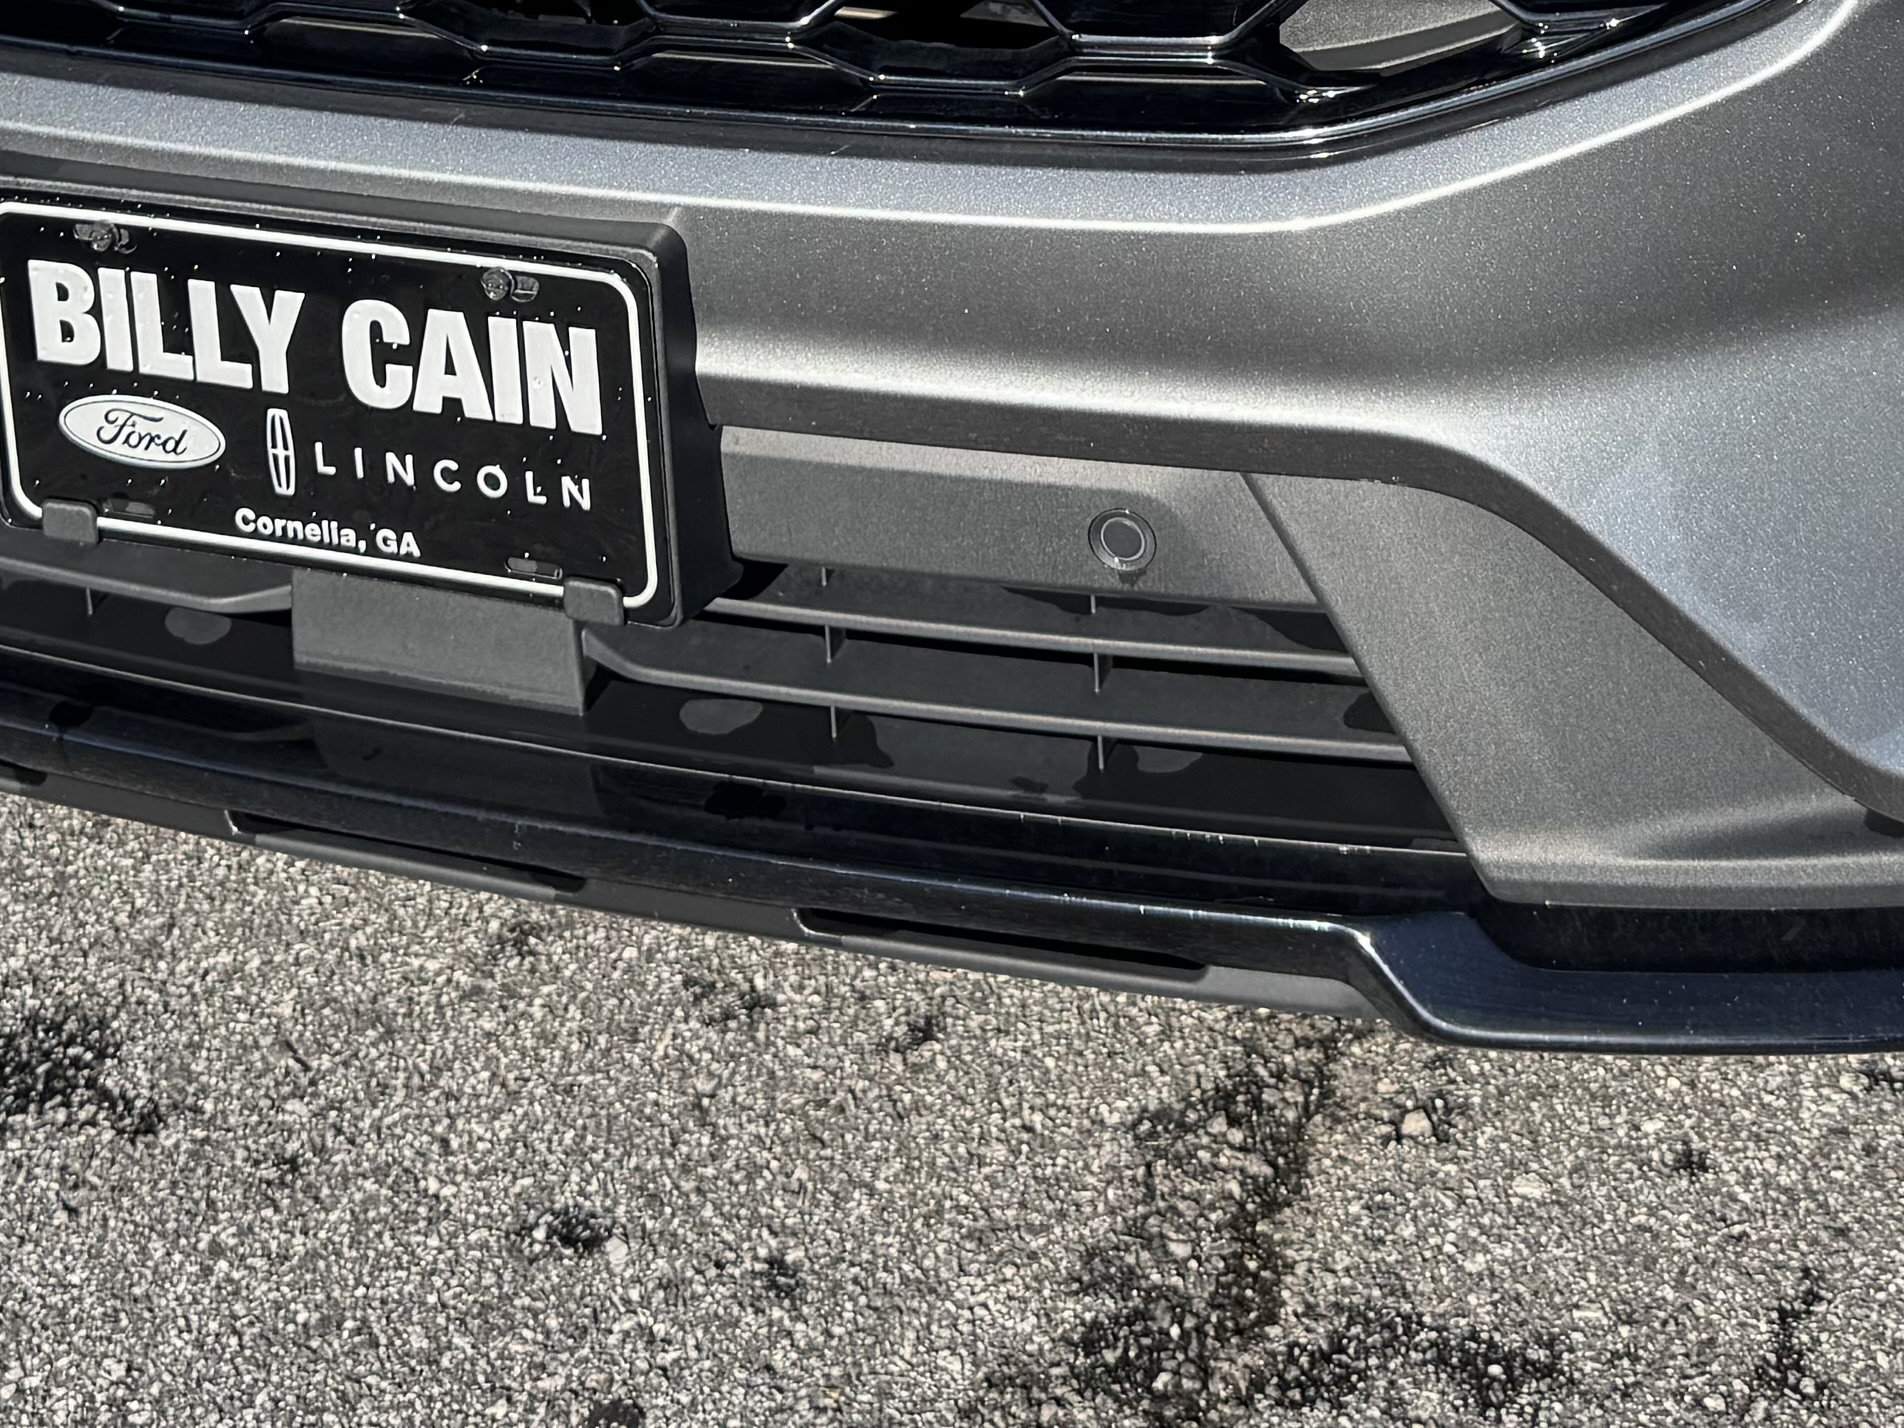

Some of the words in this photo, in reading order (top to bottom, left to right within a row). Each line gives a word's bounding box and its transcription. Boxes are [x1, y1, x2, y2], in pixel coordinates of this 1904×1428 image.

[27, 258, 306, 395] BILLY
[340, 298, 604, 437] CAIN
[95, 406, 189, 457] Ford
[314, 440, 593, 512] LINCOLN
[233, 506, 368, 554] Cornelia,
[374, 526, 423, 559] GA
